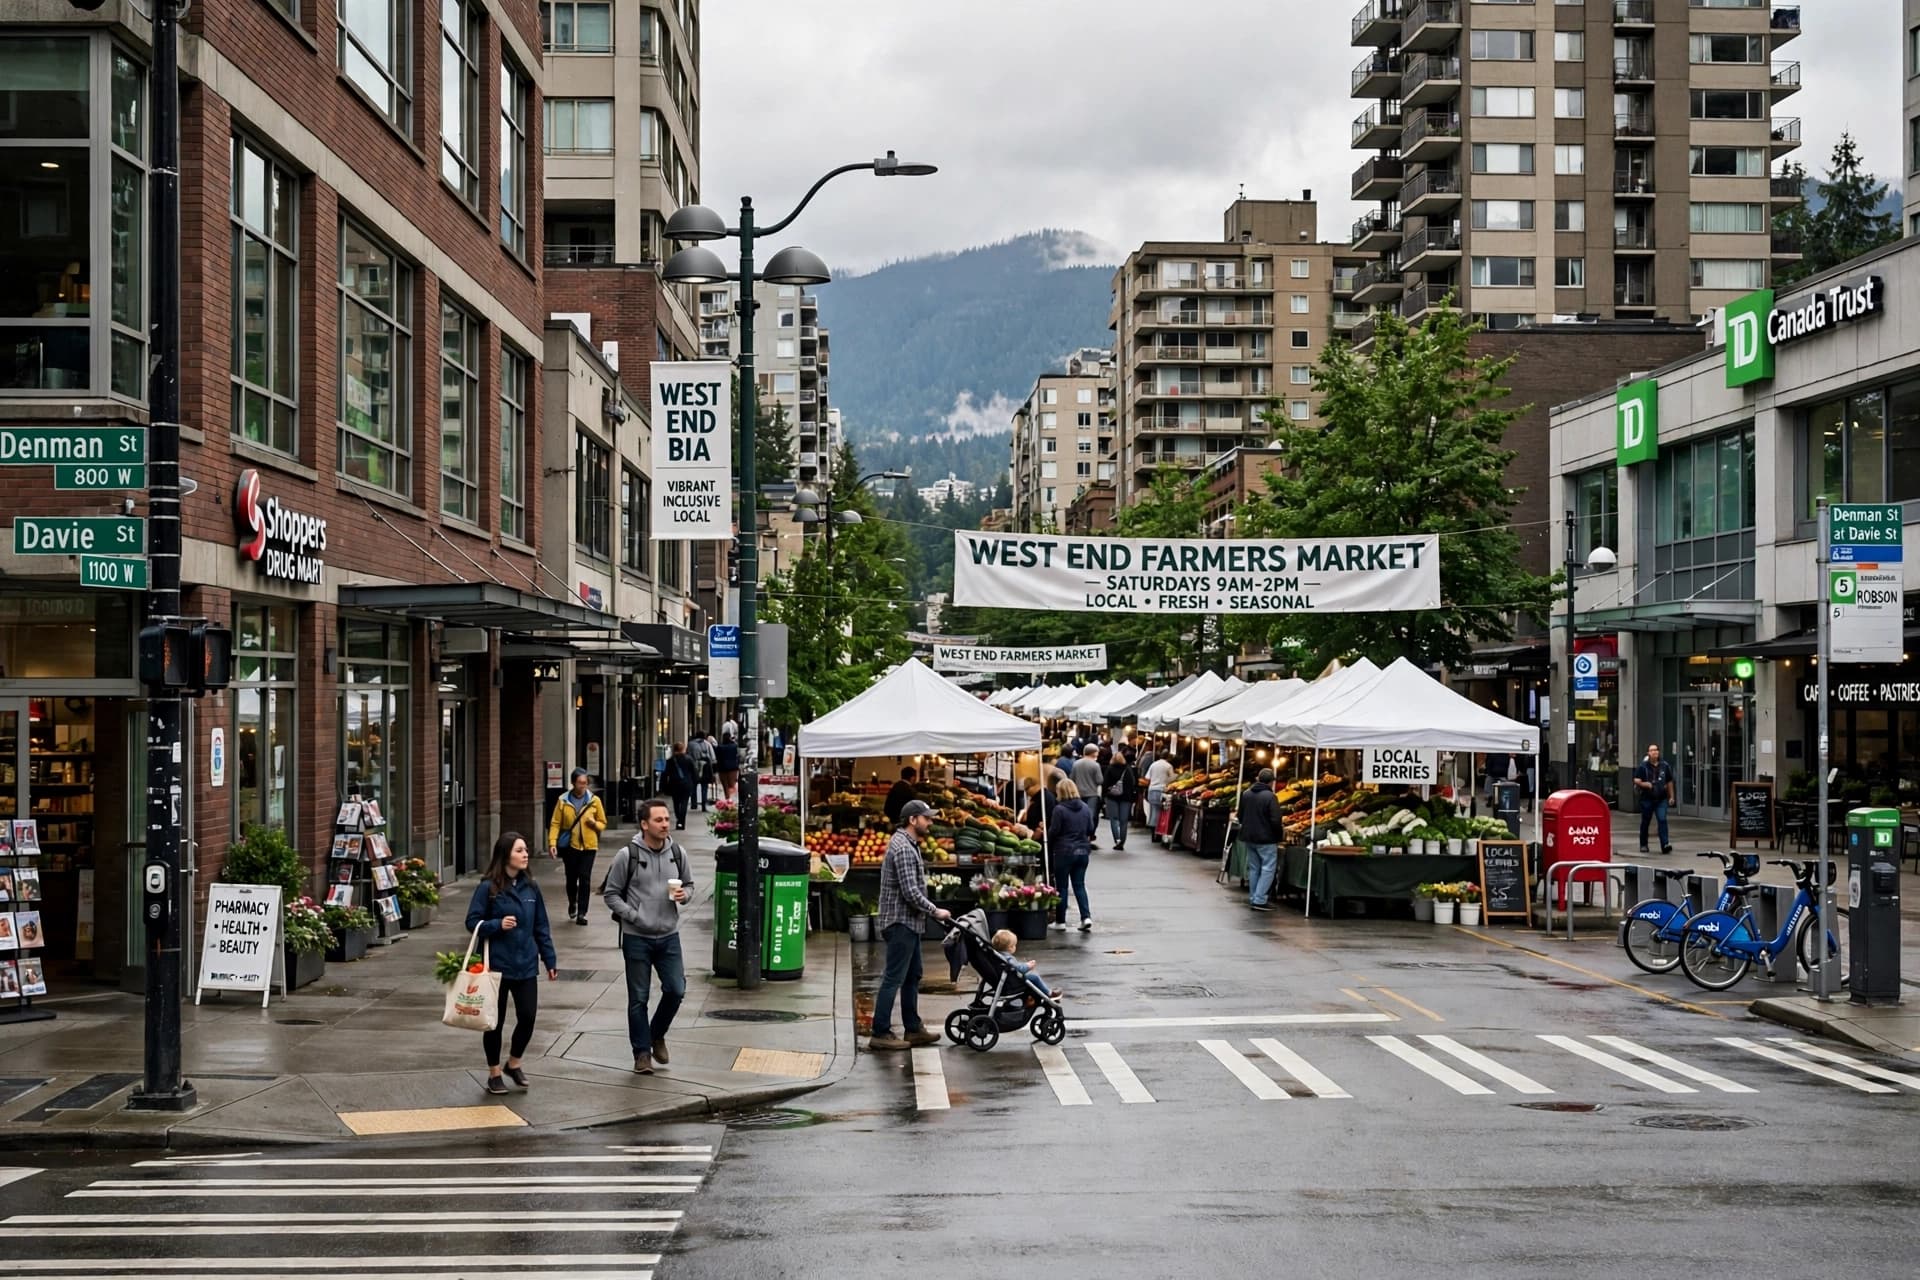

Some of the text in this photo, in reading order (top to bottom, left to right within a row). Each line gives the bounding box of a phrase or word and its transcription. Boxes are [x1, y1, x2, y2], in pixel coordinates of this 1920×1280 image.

[1767, 276, 1874, 345] Canada Trust
[1728, 311, 1758, 368] TD
[660, 382, 721, 406] WEST
[666, 410, 716, 434] END
[1619, 398, 1644, 449] TD
[0, 431, 137, 459] Denman St
[668, 437, 711, 462] BIA
[74, 468, 131, 485] 800 W
[667, 480, 716, 493] VIBRANT
[663, 495, 721, 508] INCLUSIVE
[673, 509, 711, 523] LOCAL
[1833, 507, 1899, 522] Denman St
[266, 496, 327, 555] Shoppers
[1833, 526, 1897, 540] at Davie St
[23, 521, 136, 549] Davie St
[968, 538, 1425, 572] WEST END FARMERS MARKET
[88, 560, 134, 583] 1100 W
[266, 548, 324, 585] DRUG MART
[1106, 576, 1300, 592] SATURDAYS 9AM-2PM
[1839, 578, 1848, 593] 5
[1086, 593, 1315, 610] LOCAL FRESH SEASONAL
[1857, 590, 1898, 604] ROBSON
[1833, 607, 1841, 618] 5
[939, 647, 1101, 661] WEST END FARMERS MARKET
[1804, 683, 1920, 702] CAF COFFEE PASTRIES
[1374, 749, 1423, 764] LOCAL
[1372, 765, 1430, 780] BERRIES
[214, 900, 270, 916] PHARMACY
[1640, 910, 1661, 920] mobi
[221, 920, 260, 936] HEALTH
[1697, 921, 1720, 932] mobi
[219, 940, 260, 955] BEAUTY
